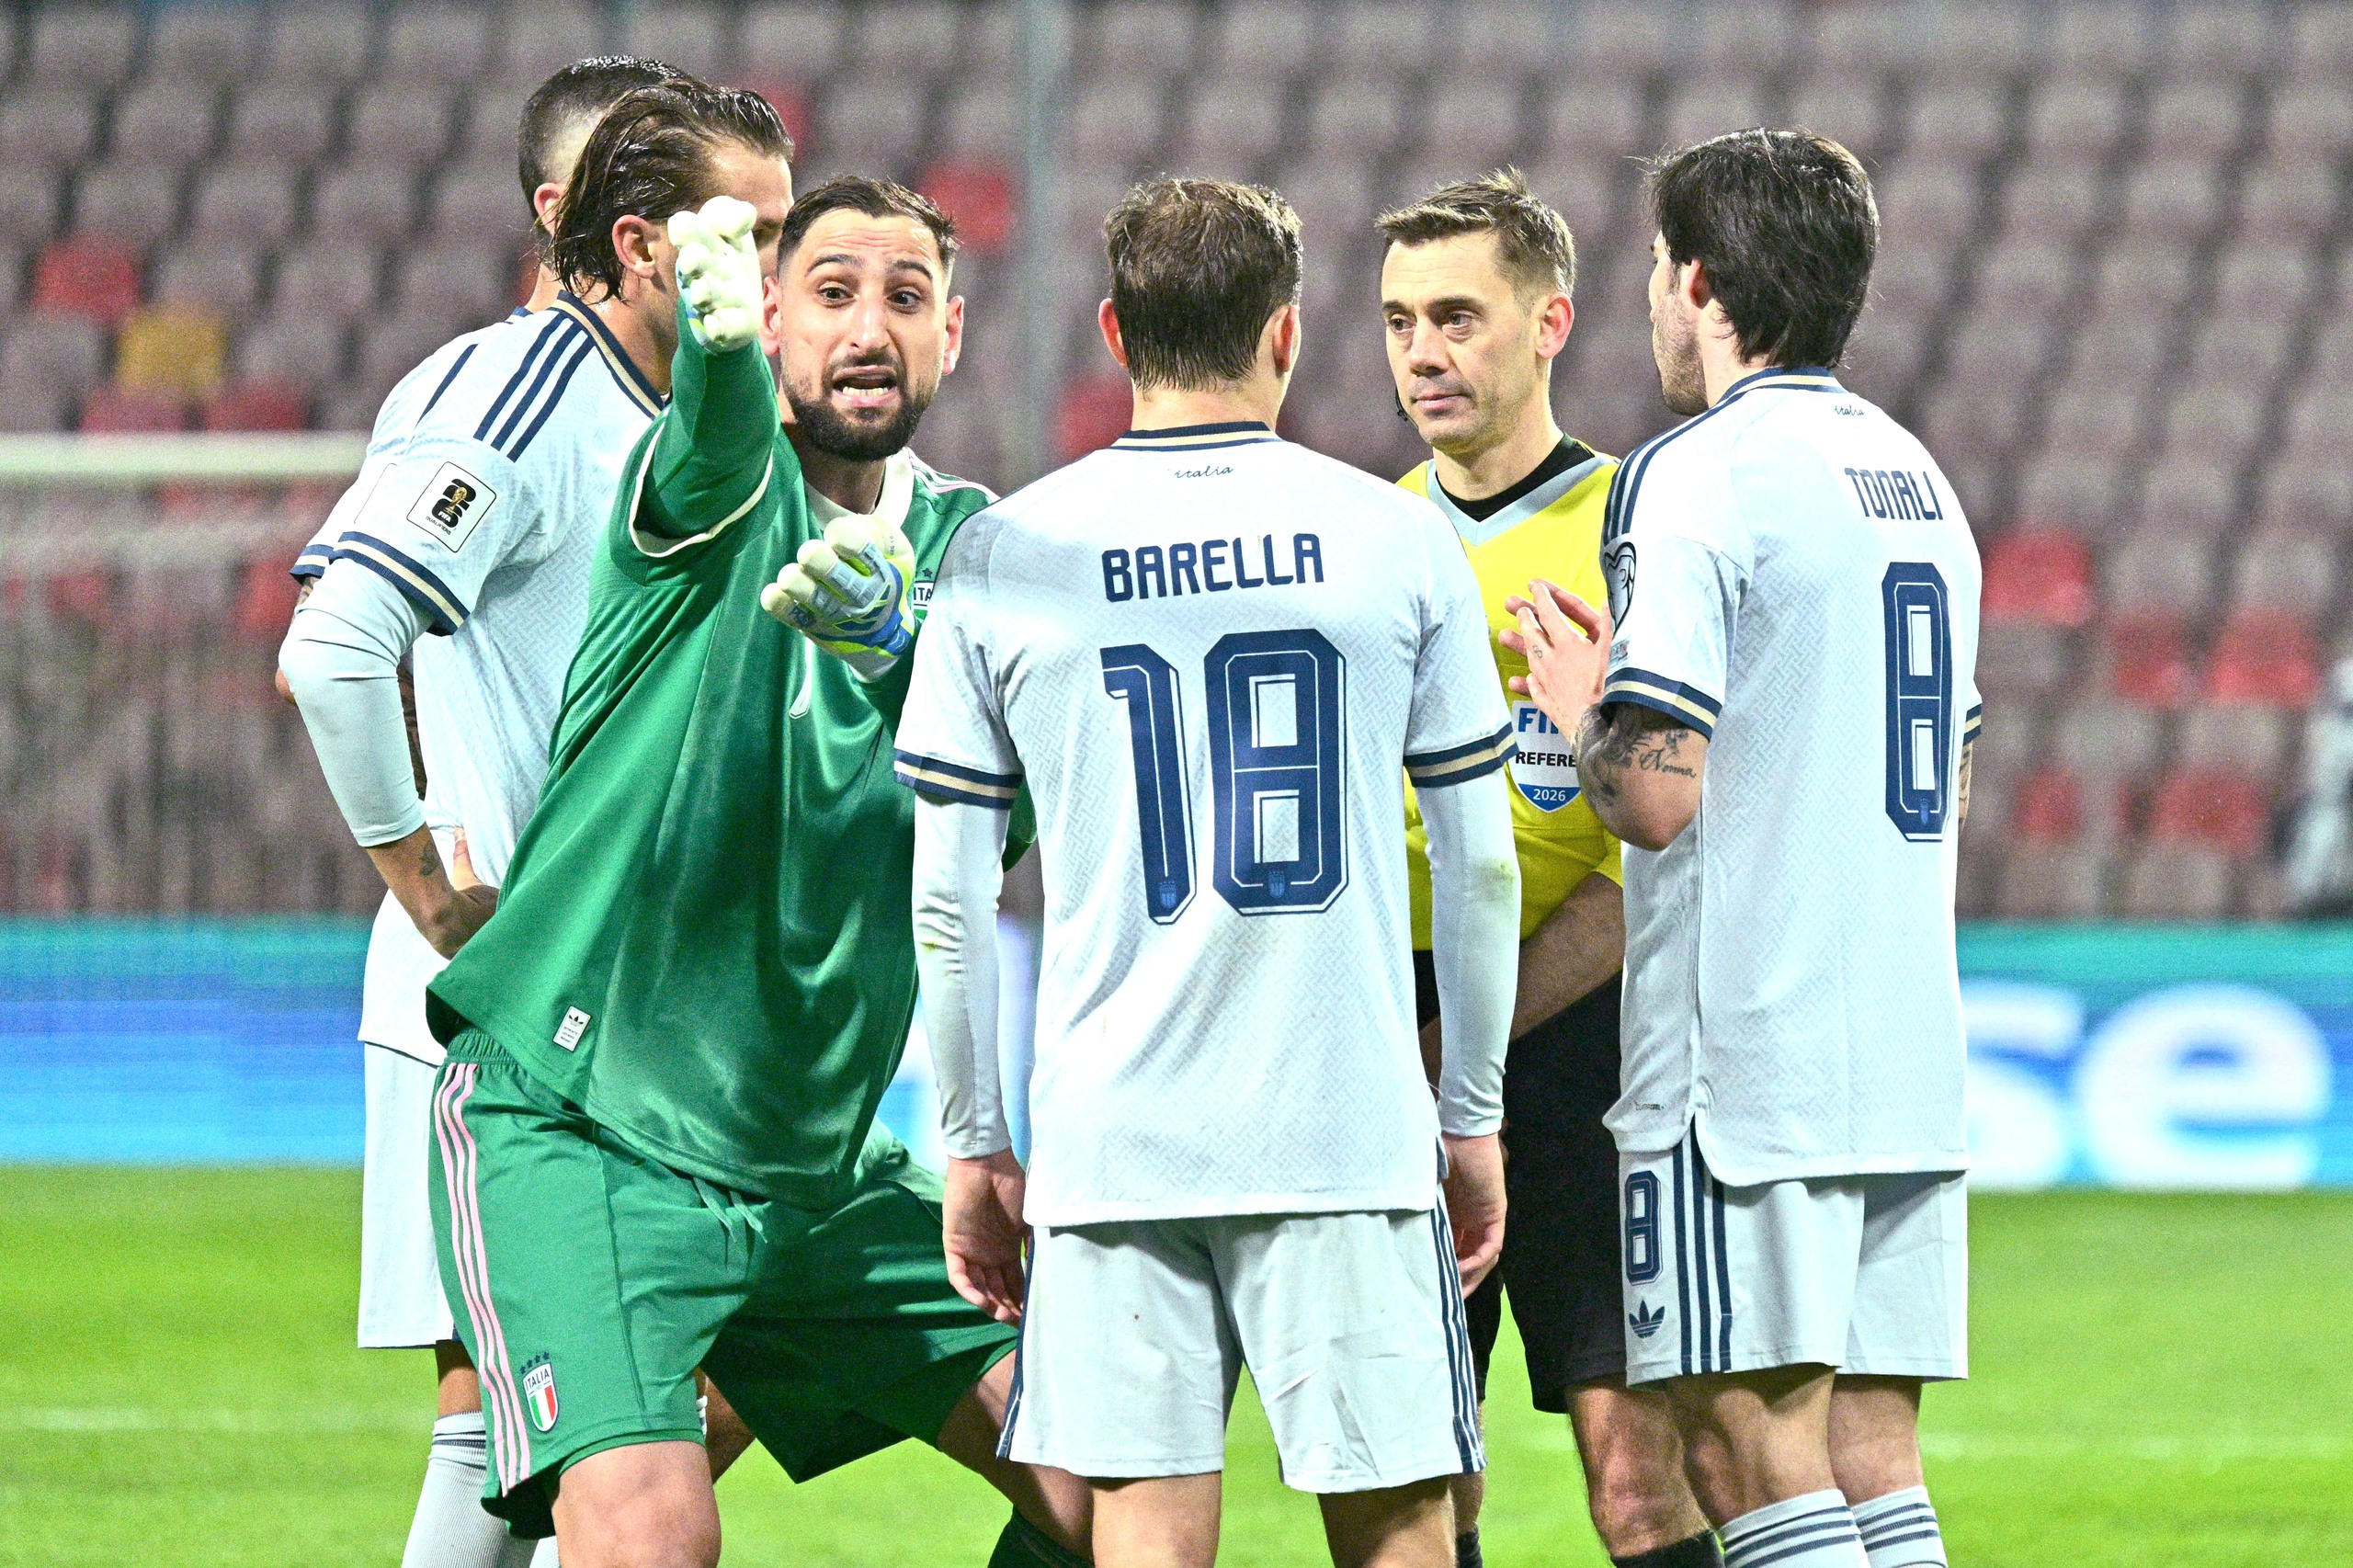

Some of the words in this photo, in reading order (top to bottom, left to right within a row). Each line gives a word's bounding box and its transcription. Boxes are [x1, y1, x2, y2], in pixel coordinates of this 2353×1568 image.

[1834, 404, 1865, 416] italia
[1174, 465, 1234, 479] italia
[1844, 467, 1944, 521] TONALI
[426, 516, 452, 536] QUALIFIERS
[1101, 533, 1324, 603] BARELLA
[1881, 562, 1955, 843] 8
[1099, 629, 1349, 926] 18
[1532, 789, 1566, 802] 2026
[1624, 1170, 1664, 1287] 8
[525, 1368, 551, 1392] ITALIA
